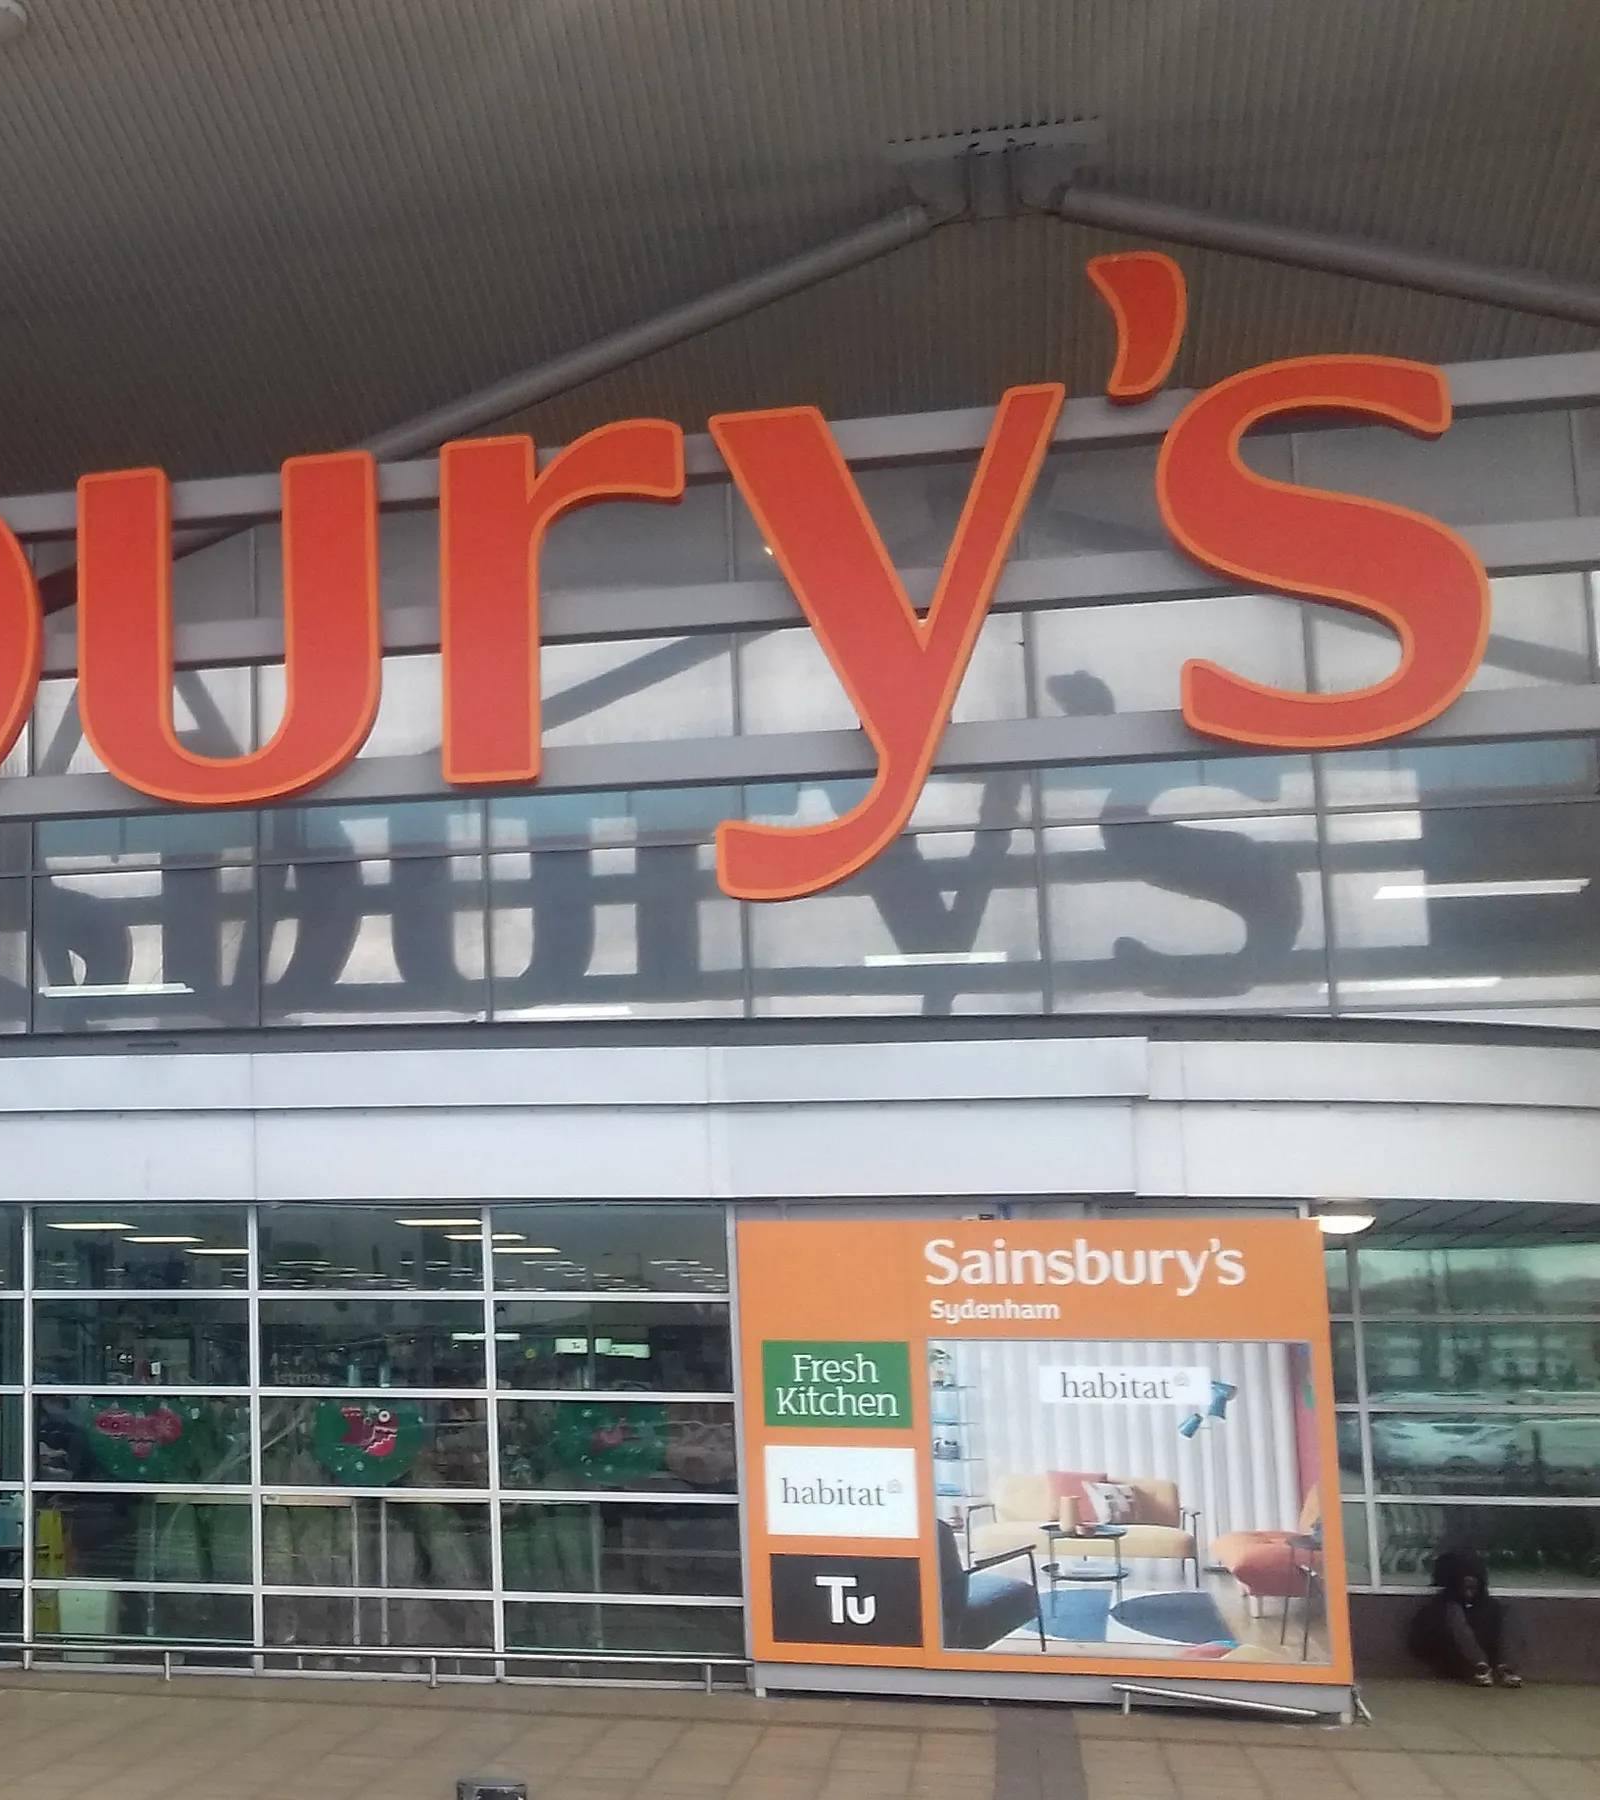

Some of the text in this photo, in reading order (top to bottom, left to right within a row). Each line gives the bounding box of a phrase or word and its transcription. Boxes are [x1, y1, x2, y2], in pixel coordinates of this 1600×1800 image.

[924, 1237, 1247, 1297] Sainsbury's
[930, 1299, 1060, 1324] Sydenham
[792, 1353, 880, 1383] Fresh
[776, 1384, 900, 1418] Kitchen
[1060, 1371, 1174, 1401] habitat
[781, 1477, 886, 1508] habitat
[815, 1575, 876, 1625] Tu
